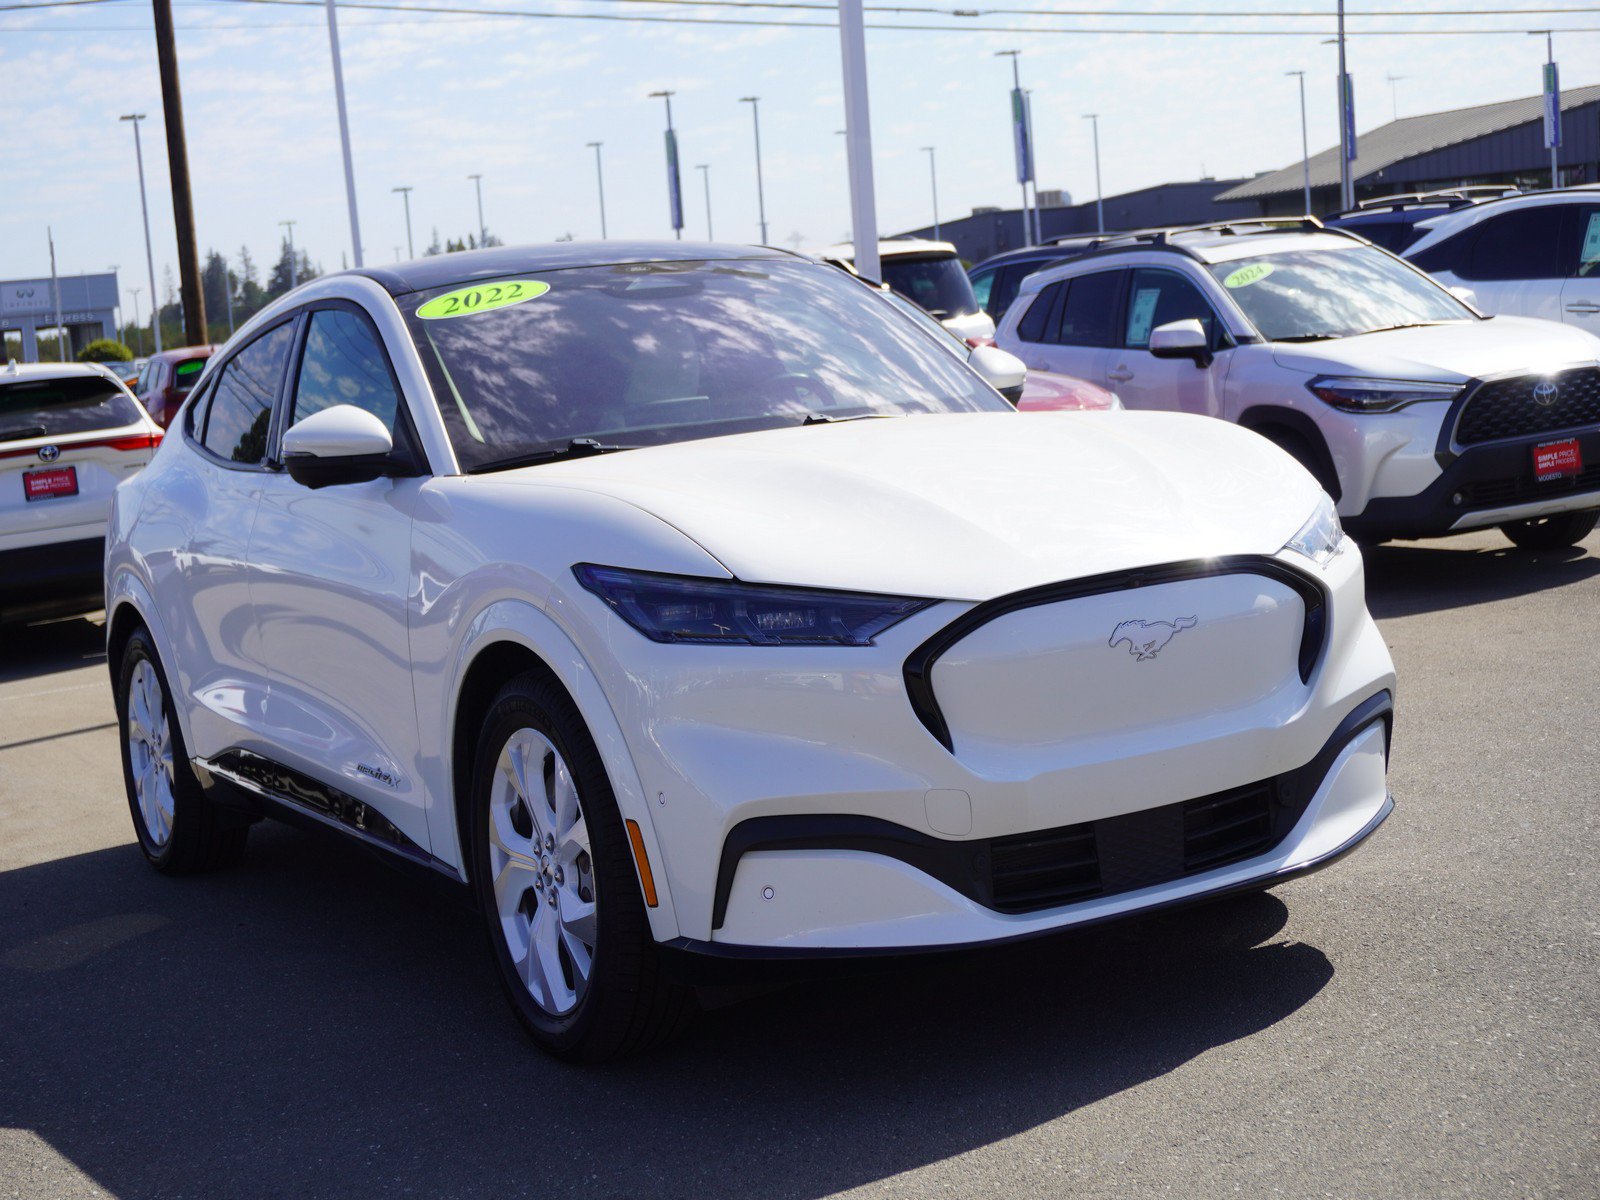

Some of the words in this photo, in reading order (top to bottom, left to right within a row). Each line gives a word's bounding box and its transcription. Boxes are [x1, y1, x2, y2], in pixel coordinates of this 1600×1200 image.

[1230, 265, 1264, 285] 2024
[443, 284, 523, 315] 2022
[1538, 452, 1558, 462] SIMPLE
[1538, 461, 1555, 469] SIMPLE
[1538, 472, 1562, 481] MODESTO
